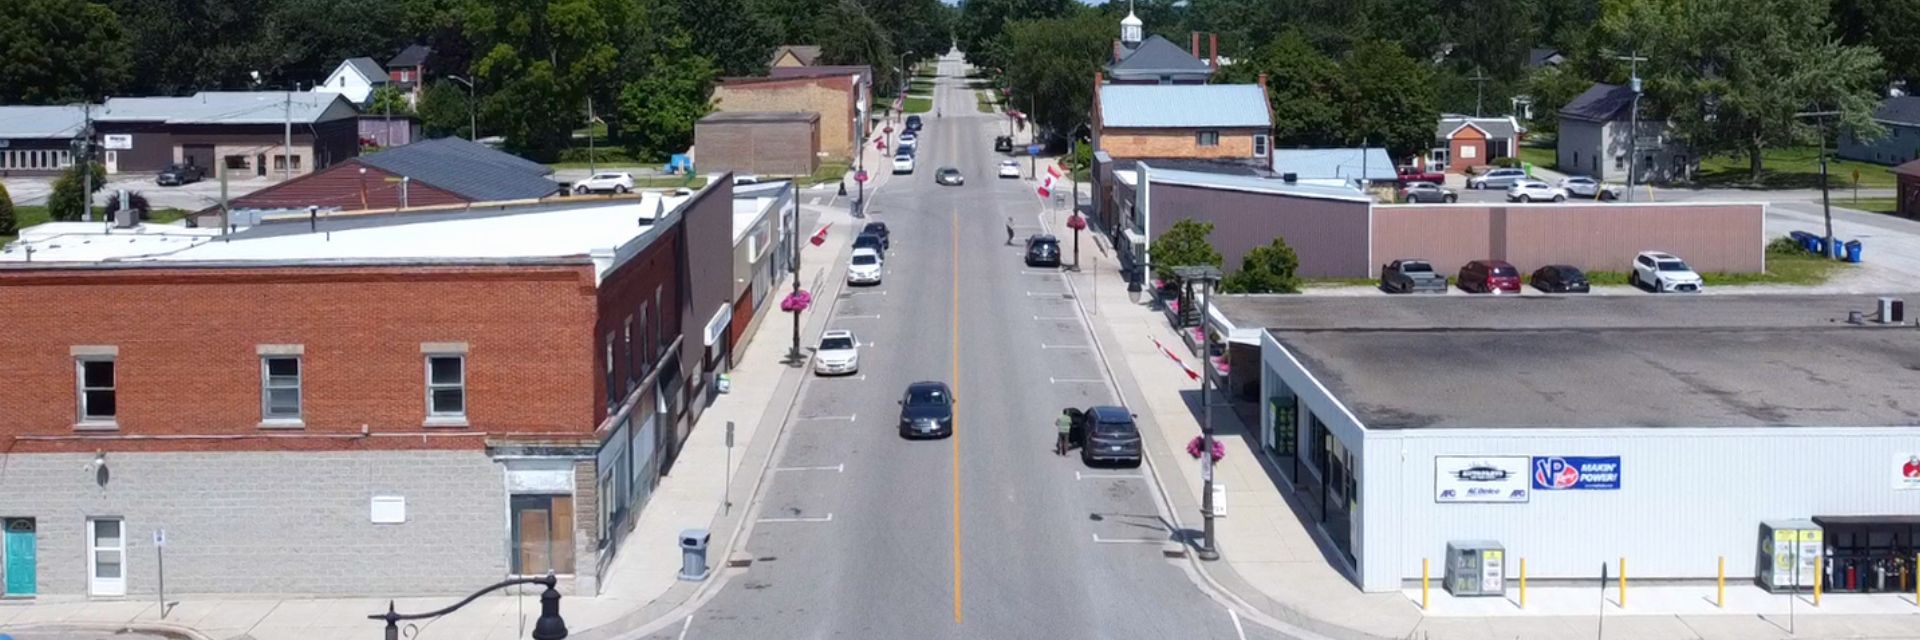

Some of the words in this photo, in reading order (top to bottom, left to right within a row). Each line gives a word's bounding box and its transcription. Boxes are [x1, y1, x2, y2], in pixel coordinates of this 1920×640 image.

[1580, 463, 1617, 472] MAKIN'
[1537, 458, 1565, 487] VP
[1579, 473, 1618, 482] POWER!
